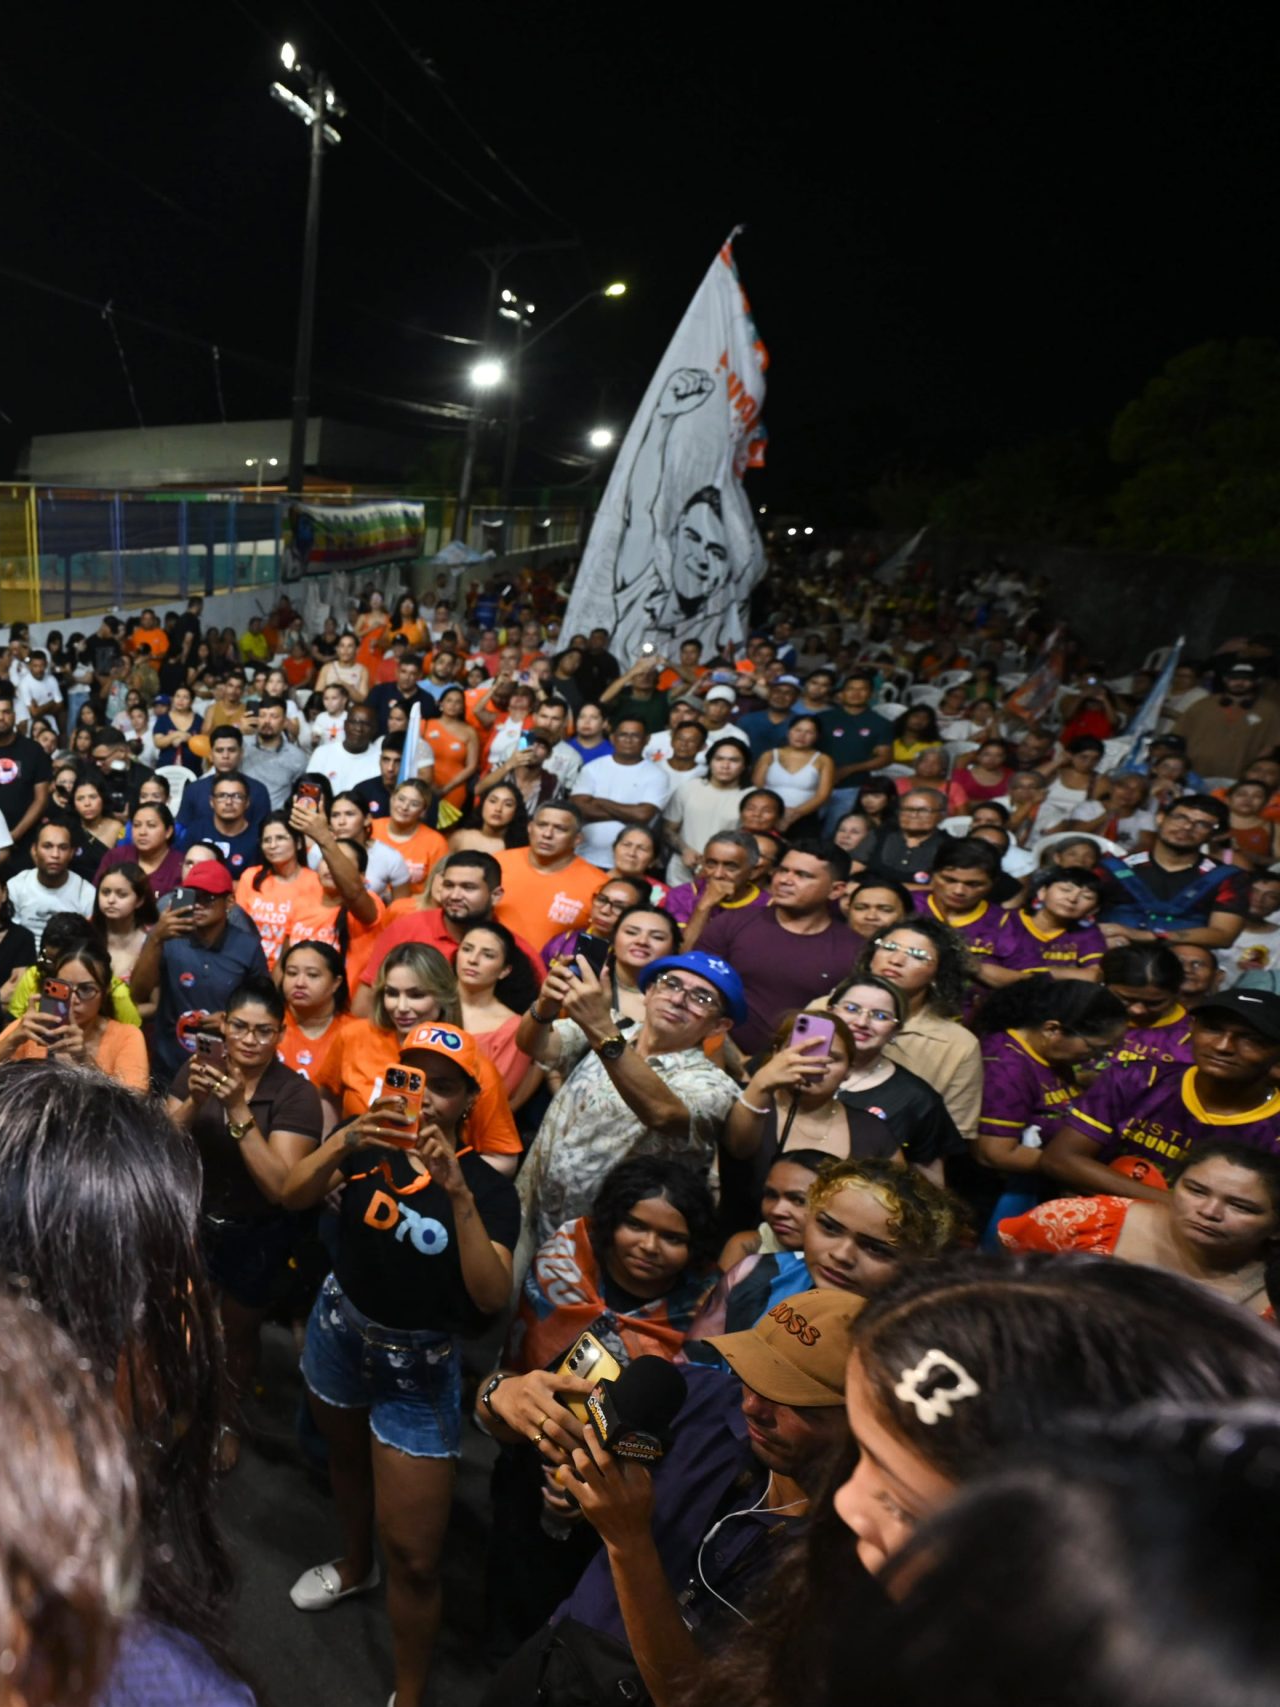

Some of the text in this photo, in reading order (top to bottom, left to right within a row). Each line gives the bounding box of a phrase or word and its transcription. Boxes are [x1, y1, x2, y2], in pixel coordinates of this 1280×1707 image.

[412, 1027, 464, 1052] D70
[363, 1189, 449, 1256] D70
[618, 1441, 656, 1452] PORTAL
